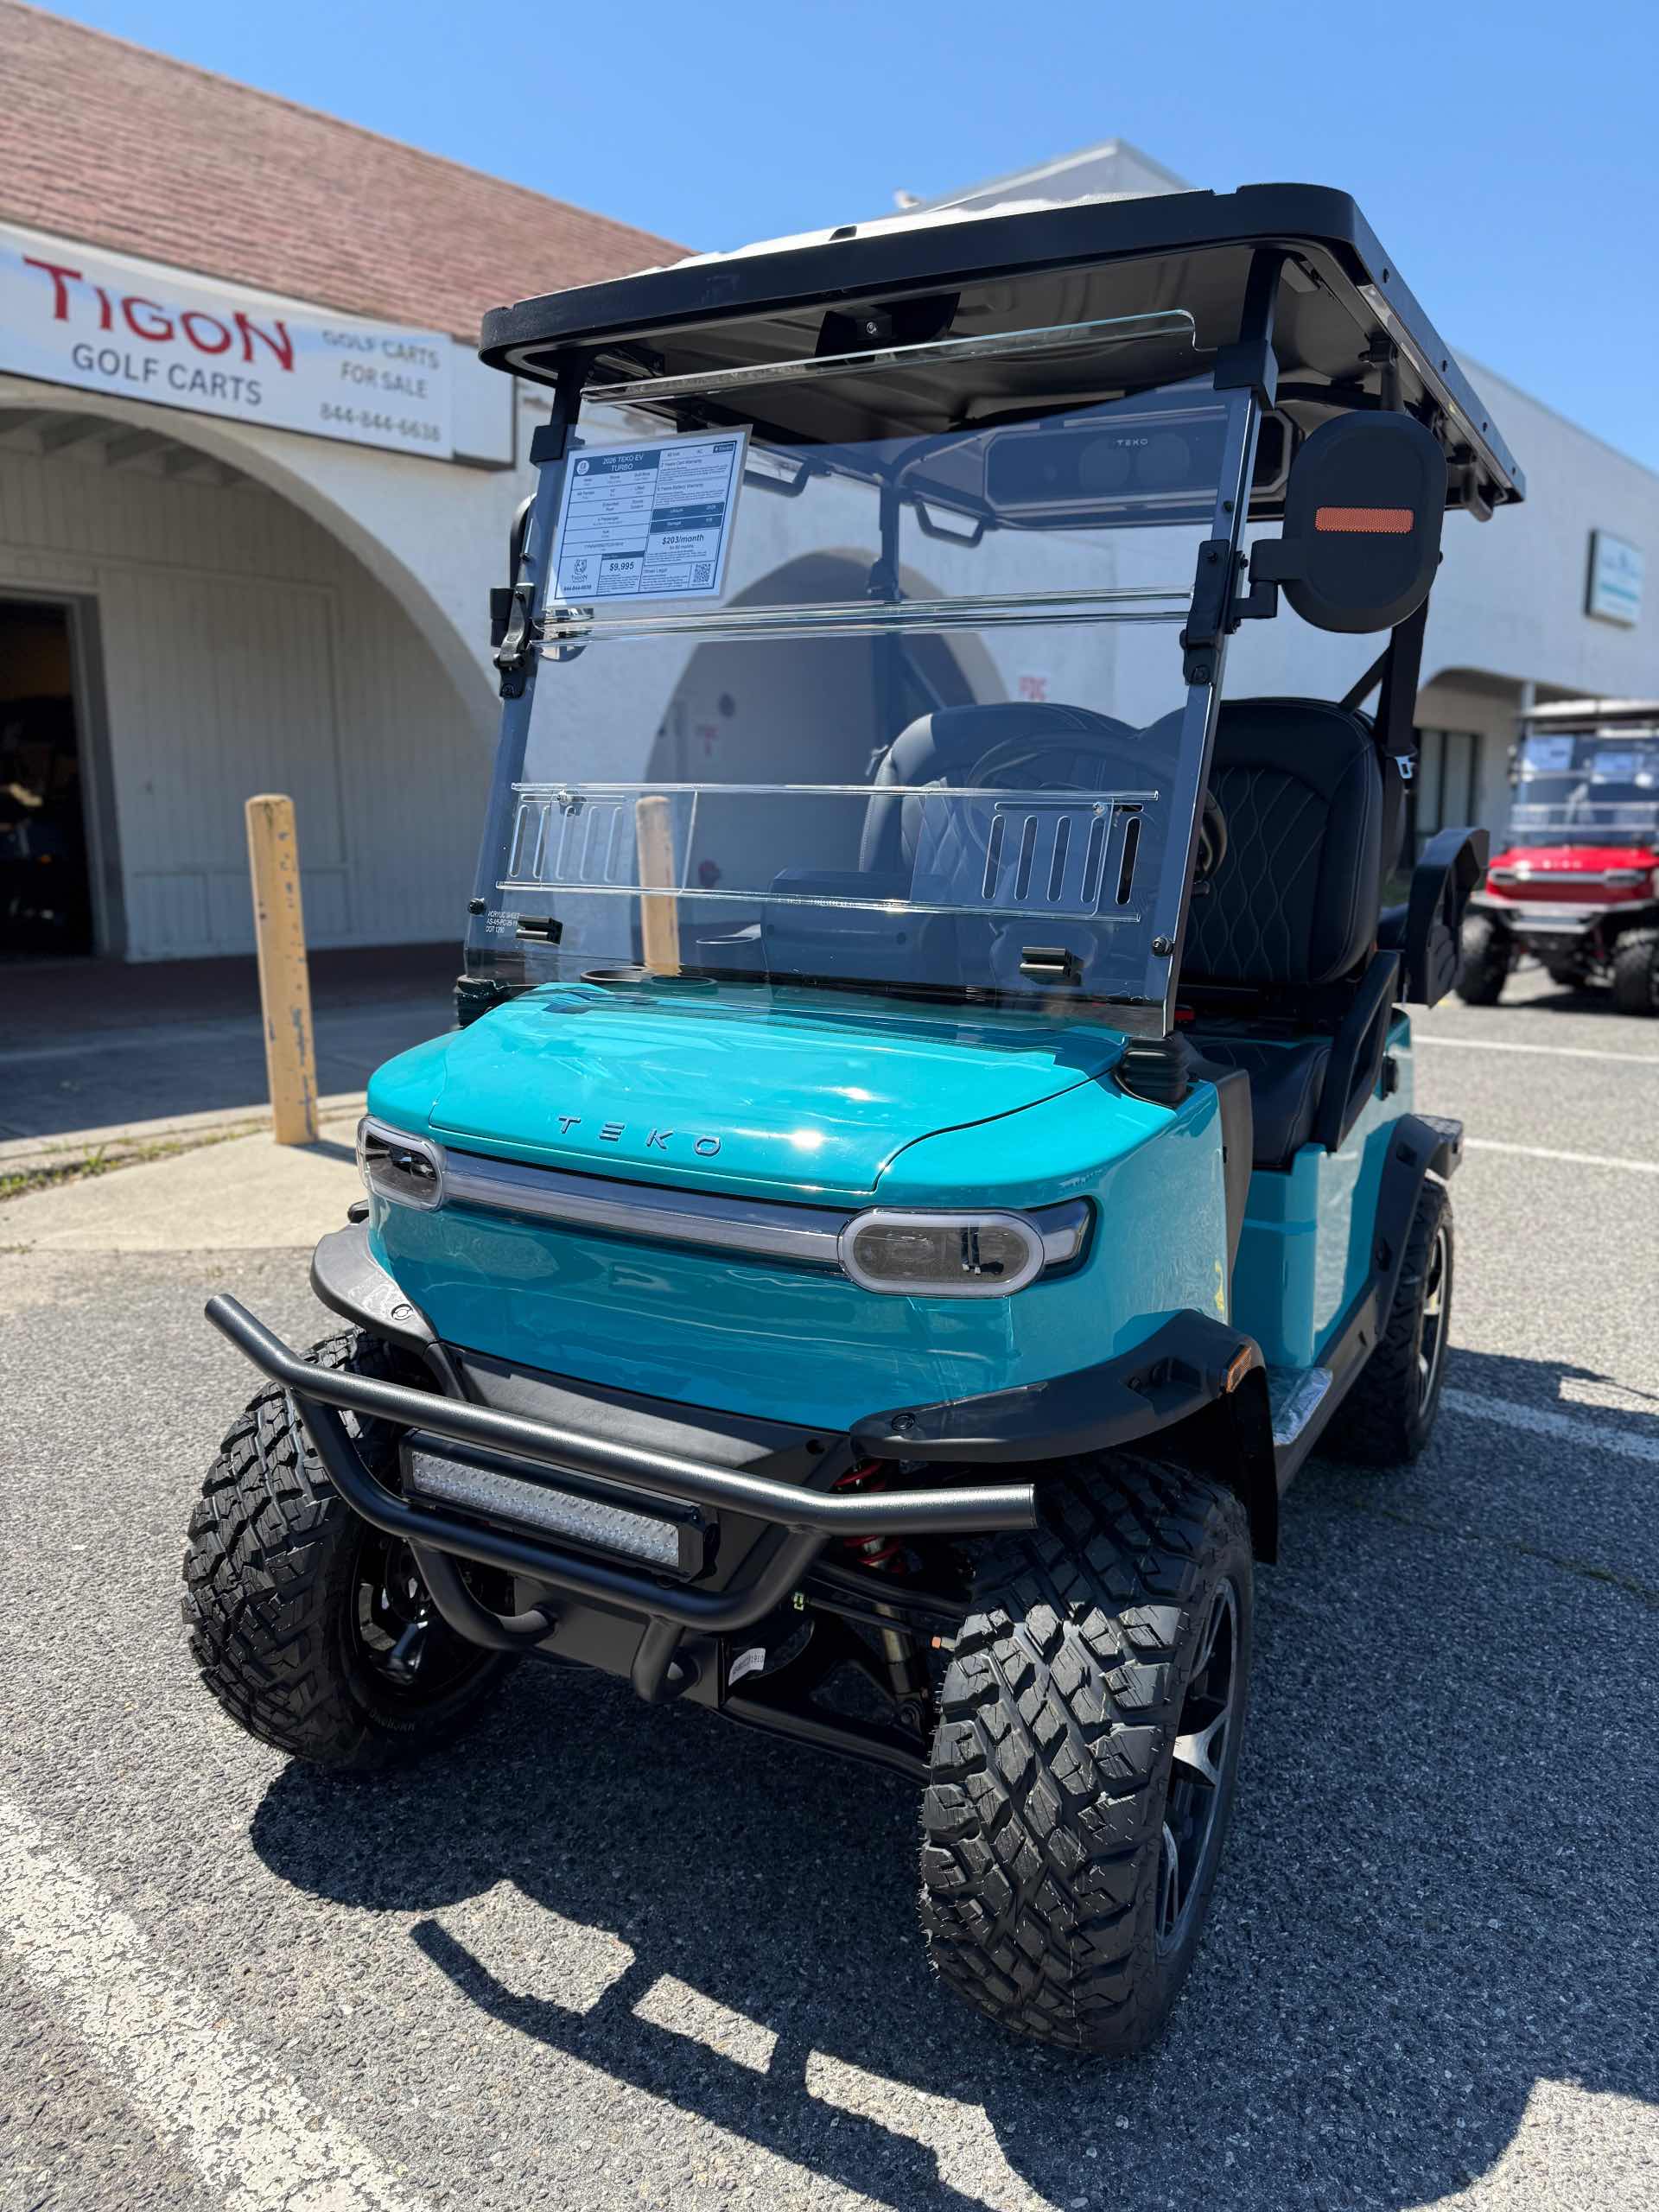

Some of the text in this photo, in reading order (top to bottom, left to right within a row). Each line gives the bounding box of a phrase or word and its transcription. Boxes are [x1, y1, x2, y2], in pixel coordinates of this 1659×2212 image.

[22, 254, 296, 372] TIGON
[322, 330, 441, 370] GOLF CARTS
[72, 343, 262, 406] GOLF CARTS
[340, 359, 429, 399] FOR SALE
[1116, 438, 1148, 447] TEKO
[662, 534, 704, 545] $203/month
[609, 562, 634, 572] $9,995
[557, 1115, 721, 1157] TEKO
